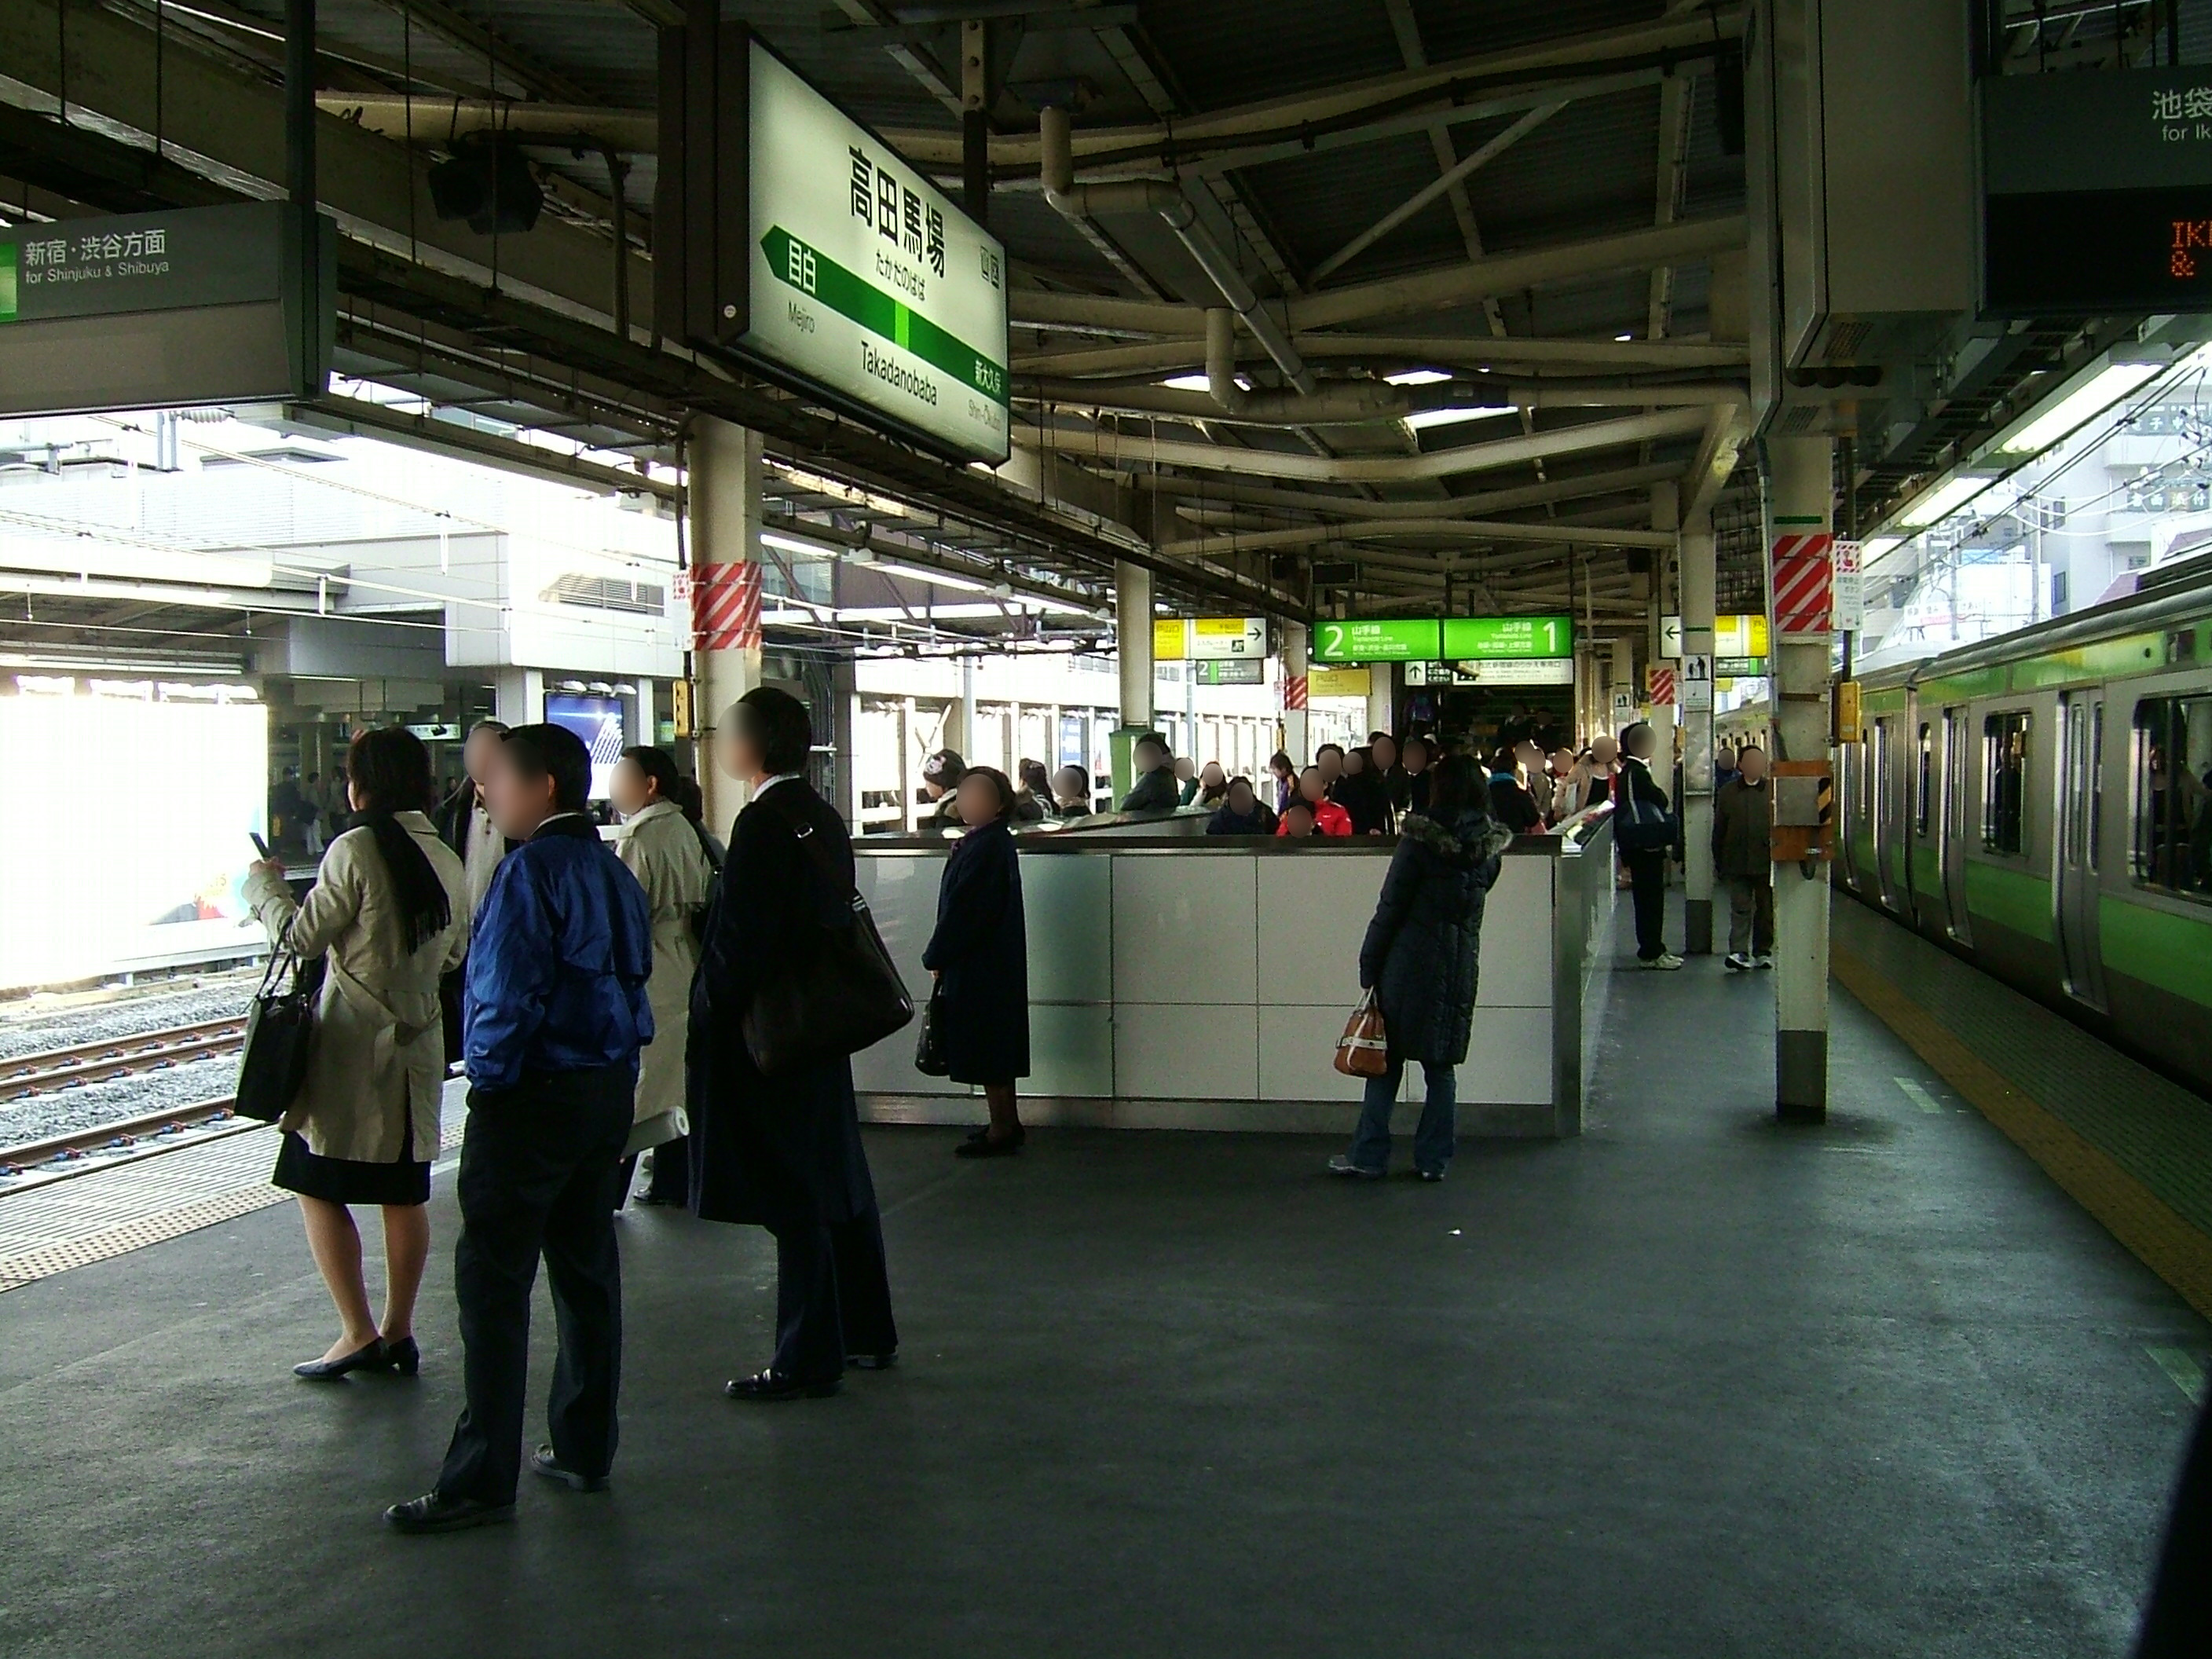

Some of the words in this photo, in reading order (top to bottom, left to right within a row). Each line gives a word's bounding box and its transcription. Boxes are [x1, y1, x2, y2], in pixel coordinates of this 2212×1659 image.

[2162, 123, 2188, 141] for
[848, 144, 944, 278] 高田馬場
[25, 229, 166, 266] 新宿・渋谷方面
[2171, 219, 2212, 248] IK
[25, 269, 42, 284] for
[47, 265, 102, 283] Shinjuku
[104, 264, 113, 278] &
[118, 260, 170, 276] Shibuya
[788, 238, 816, 295] 目白
[876, 248, 925, 302] たかだのばば
[2171, 249, 2195, 276] &
[788, 299, 816, 335] Mejiro
[861, 339, 937, 407] Takadanobaba
[1324, 624, 1344, 657] 2
[1542, 621, 1556, 653] 1
[1198, 661, 1210, 676] 2
